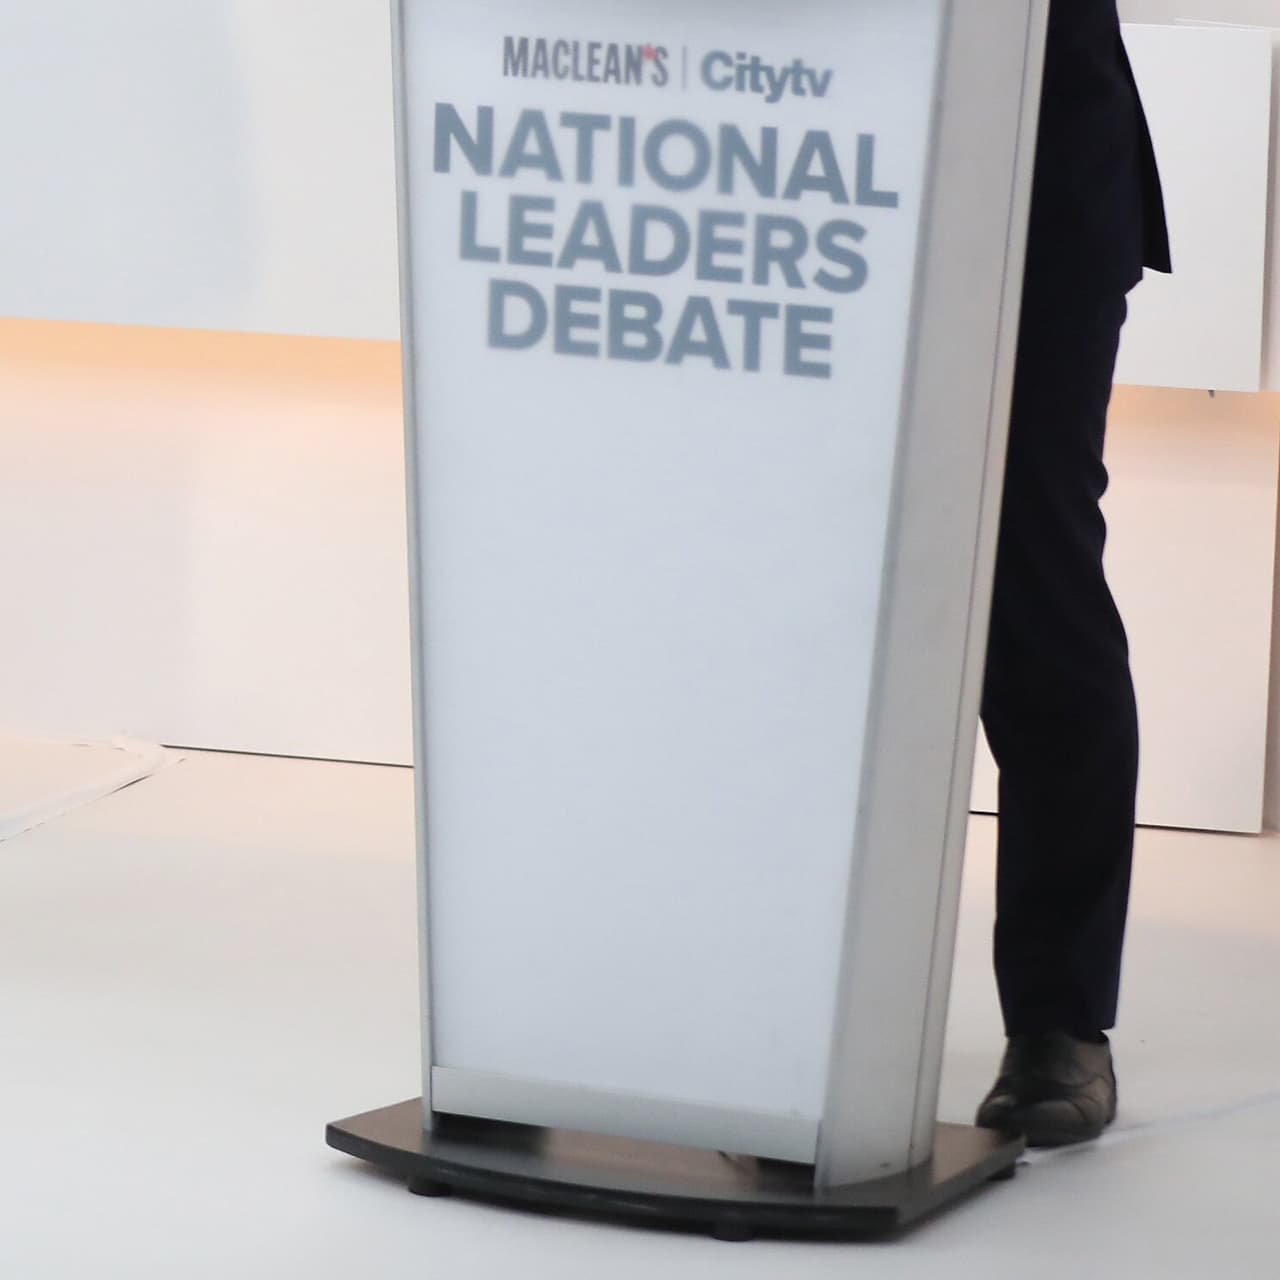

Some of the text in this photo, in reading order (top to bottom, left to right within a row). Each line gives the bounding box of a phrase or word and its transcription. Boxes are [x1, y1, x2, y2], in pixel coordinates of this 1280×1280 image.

[503, 36, 833, 104] MACLEAN'S Citytv
[433, 102, 899, 209] NATIONAL
[459, 190, 869, 294] LEADERS
[487, 278, 833, 380] DEBATE
